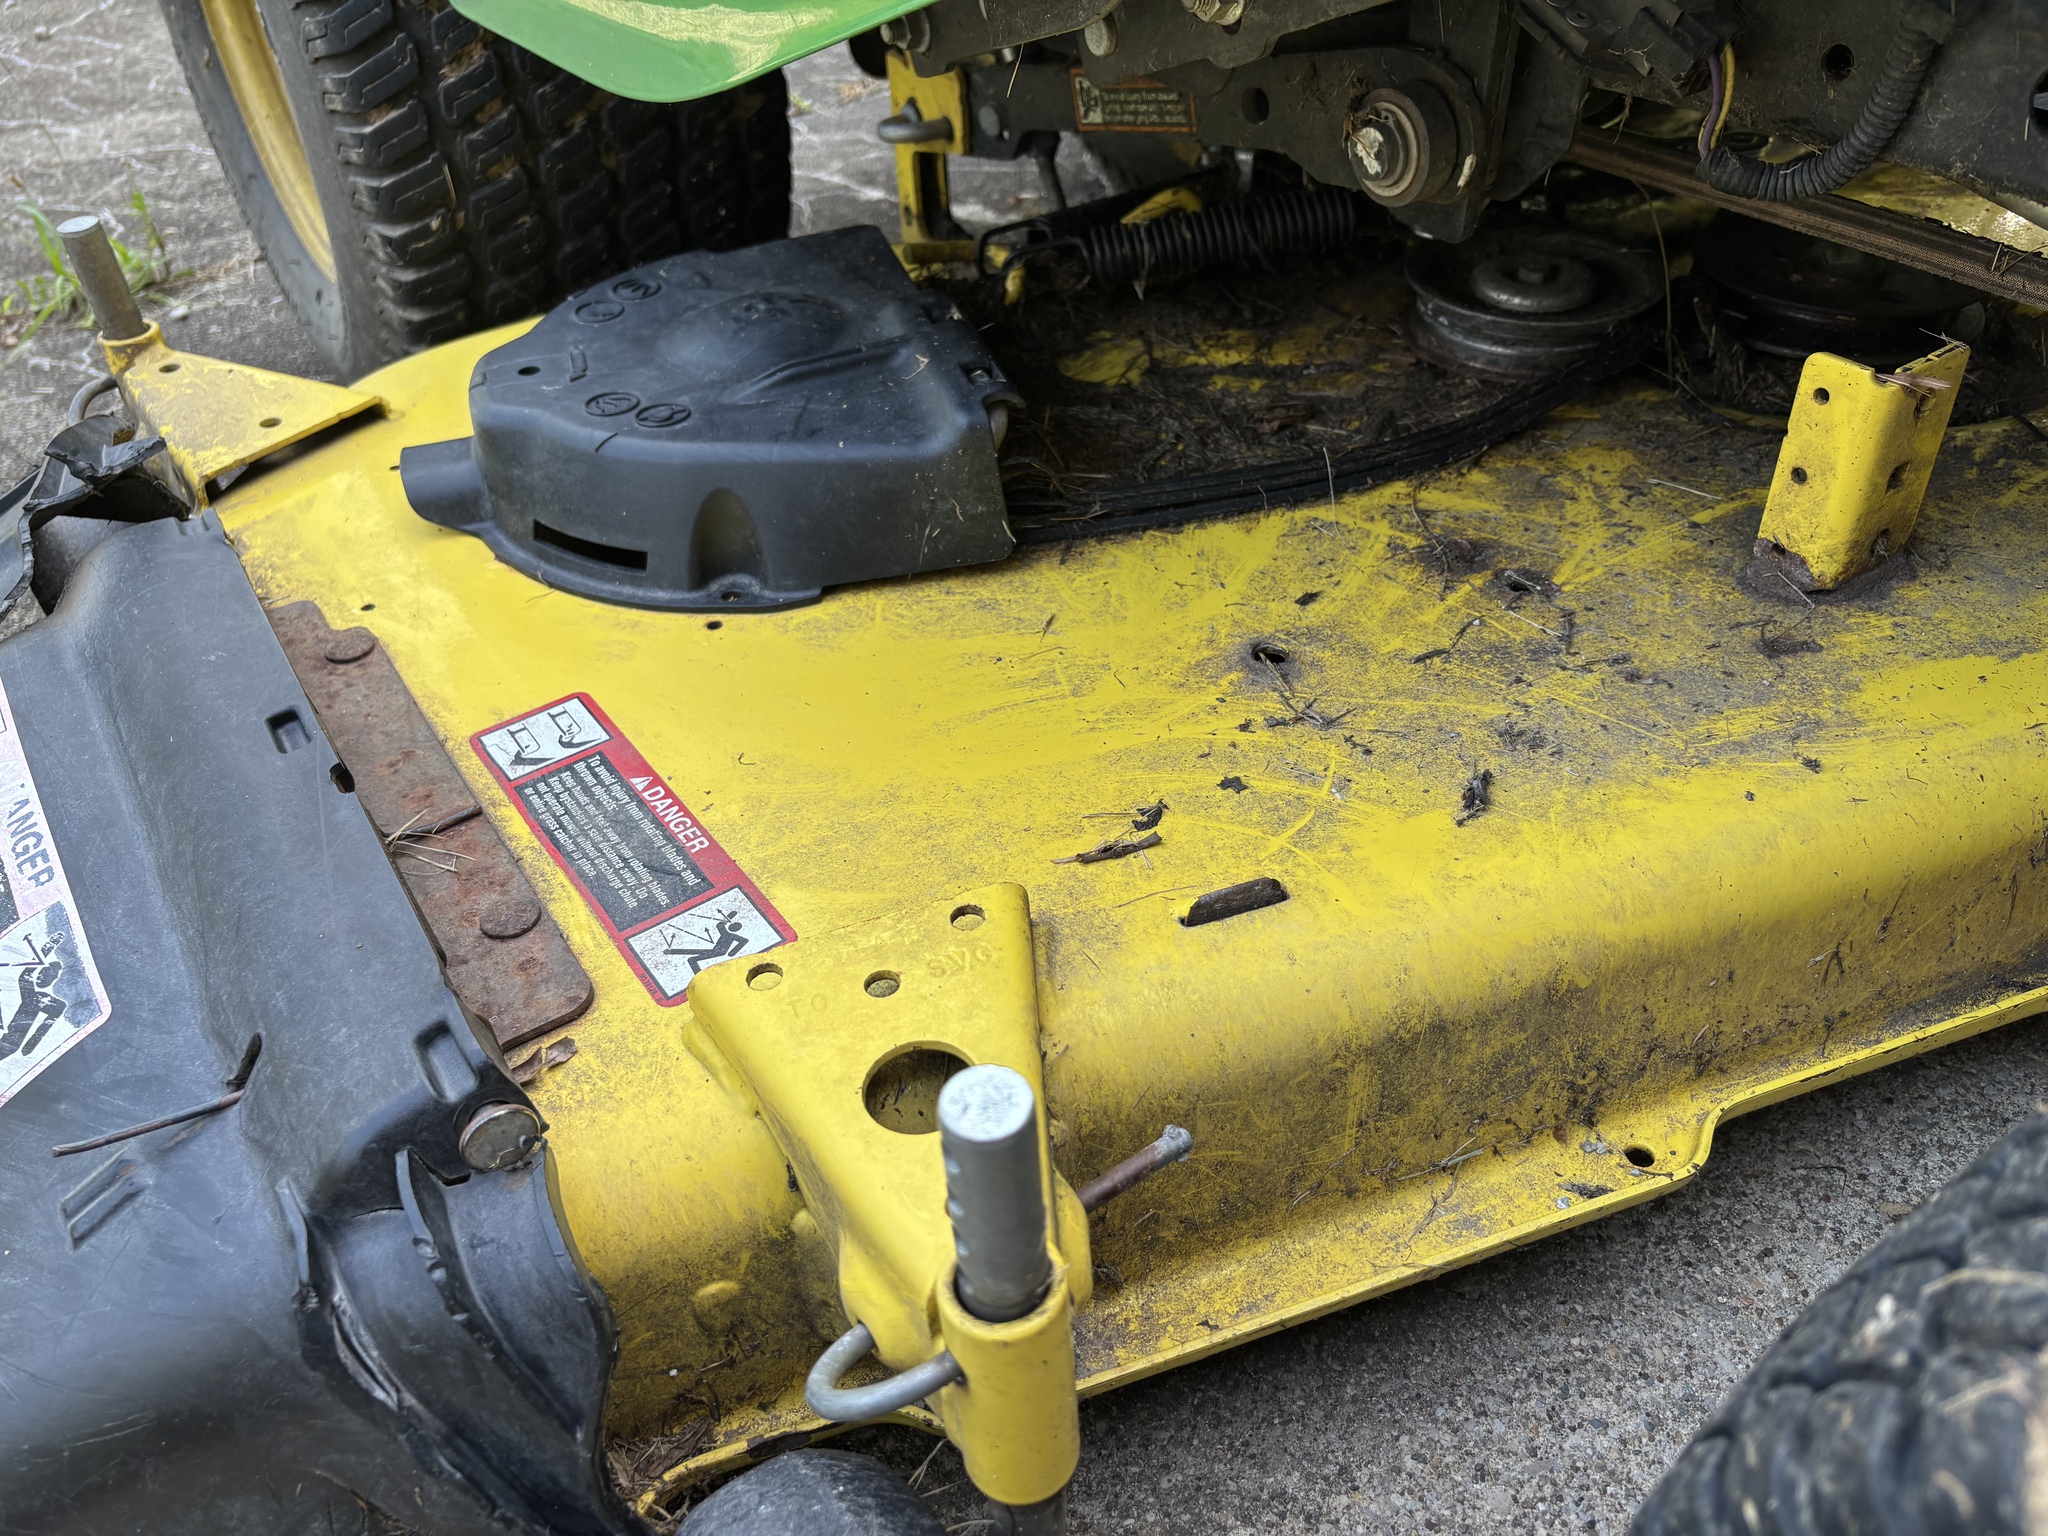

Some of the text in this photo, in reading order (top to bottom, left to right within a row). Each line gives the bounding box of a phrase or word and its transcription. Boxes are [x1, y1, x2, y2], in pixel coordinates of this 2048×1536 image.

[6, 782, 55, 889] ANGER
[523, 786, 596, 879] or entire grass catcher in place.
[535, 780, 637, 908] not operate mower without discharge chute
[547, 775, 649, 900] Keep bystanders a safe distance away. Do
[559, 770, 669, 907] Keep hands and feet away from rotating blades.
[573, 760, 619, 813] thrown objects:
[586, 753, 701, 886] To avoid injury from rotating blades and
[641, 785, 709, 853] DANGER
